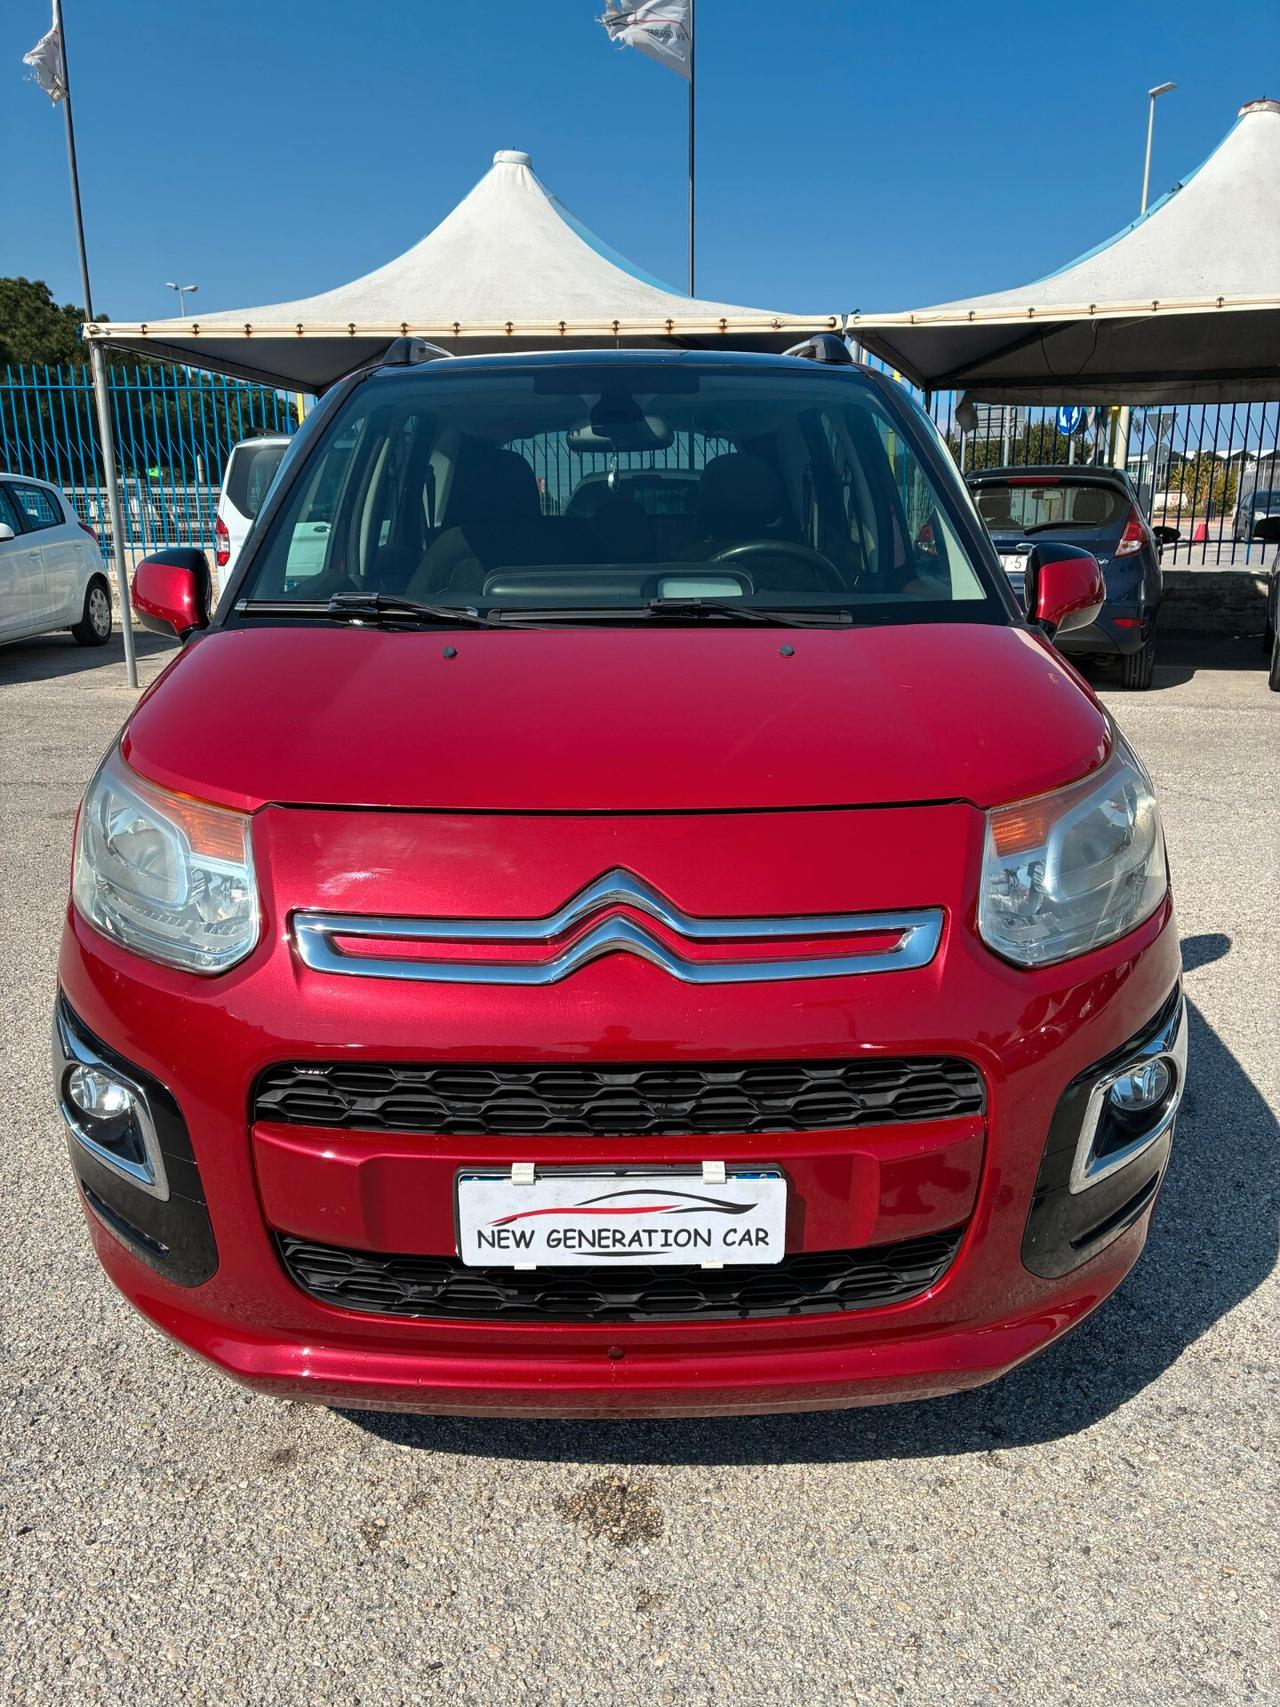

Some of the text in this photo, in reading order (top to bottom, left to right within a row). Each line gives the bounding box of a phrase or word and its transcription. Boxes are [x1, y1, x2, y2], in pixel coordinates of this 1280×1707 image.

[477, 1227, 769, 1249] NEW GENERATION CAR
